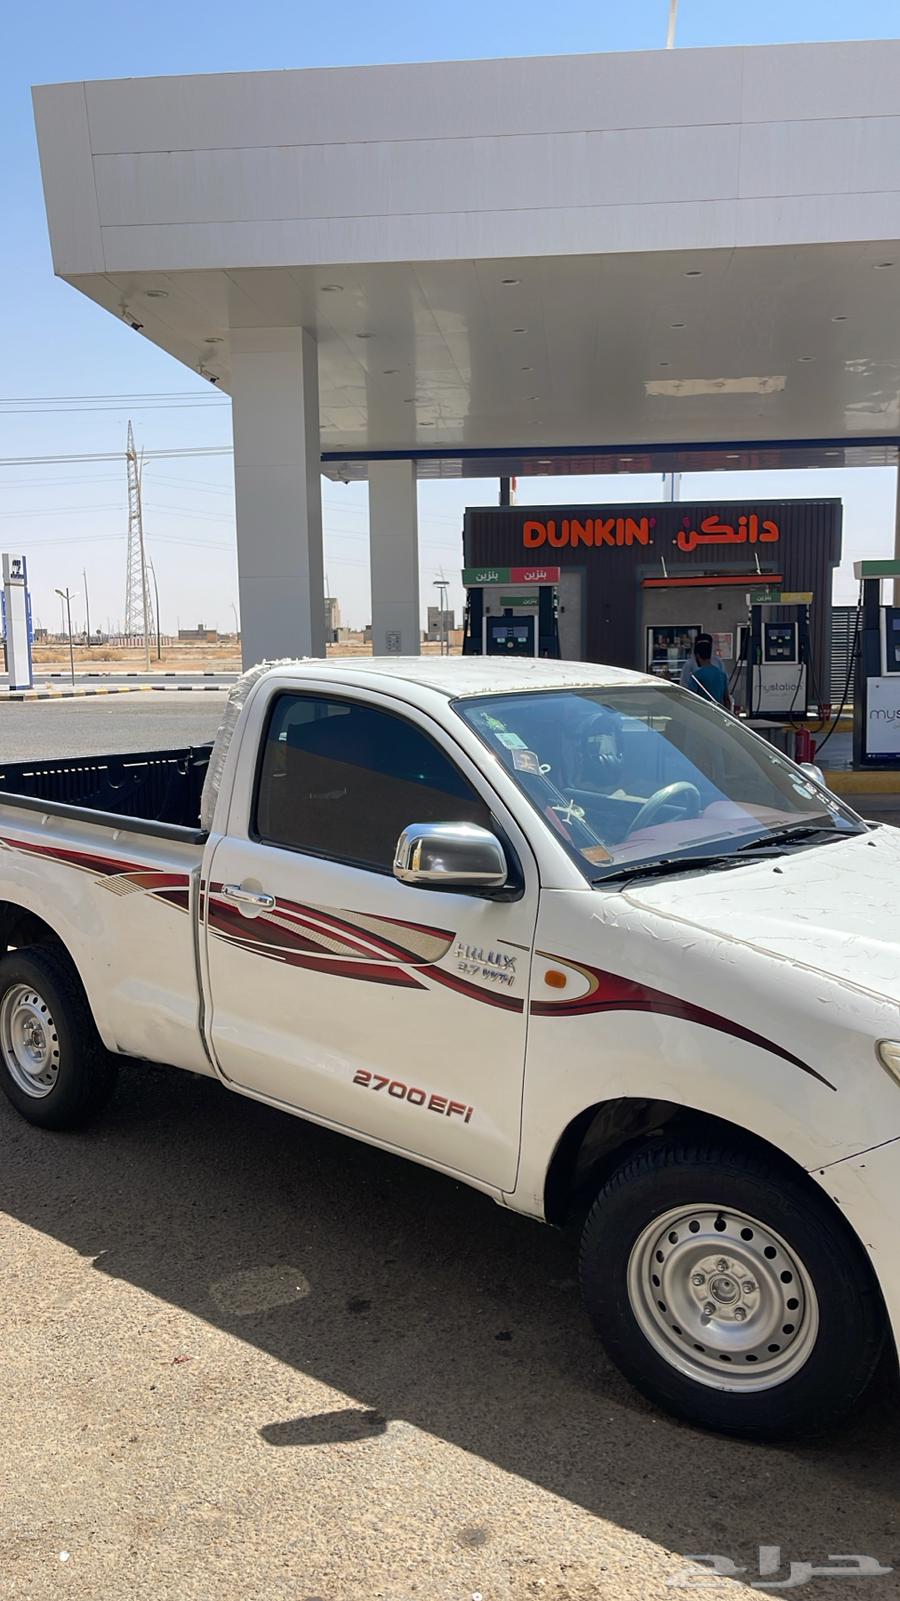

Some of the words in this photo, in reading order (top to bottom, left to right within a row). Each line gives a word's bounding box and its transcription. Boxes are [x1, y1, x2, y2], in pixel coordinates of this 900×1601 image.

[677, 514, 779, 552] دانكن
[475, 570, 499, 582] بنزين
[523, 569, 547, 581] بنزين
[454, 943, 517, 973] HILUX
[352, 1069, 427, 1106] 2700
